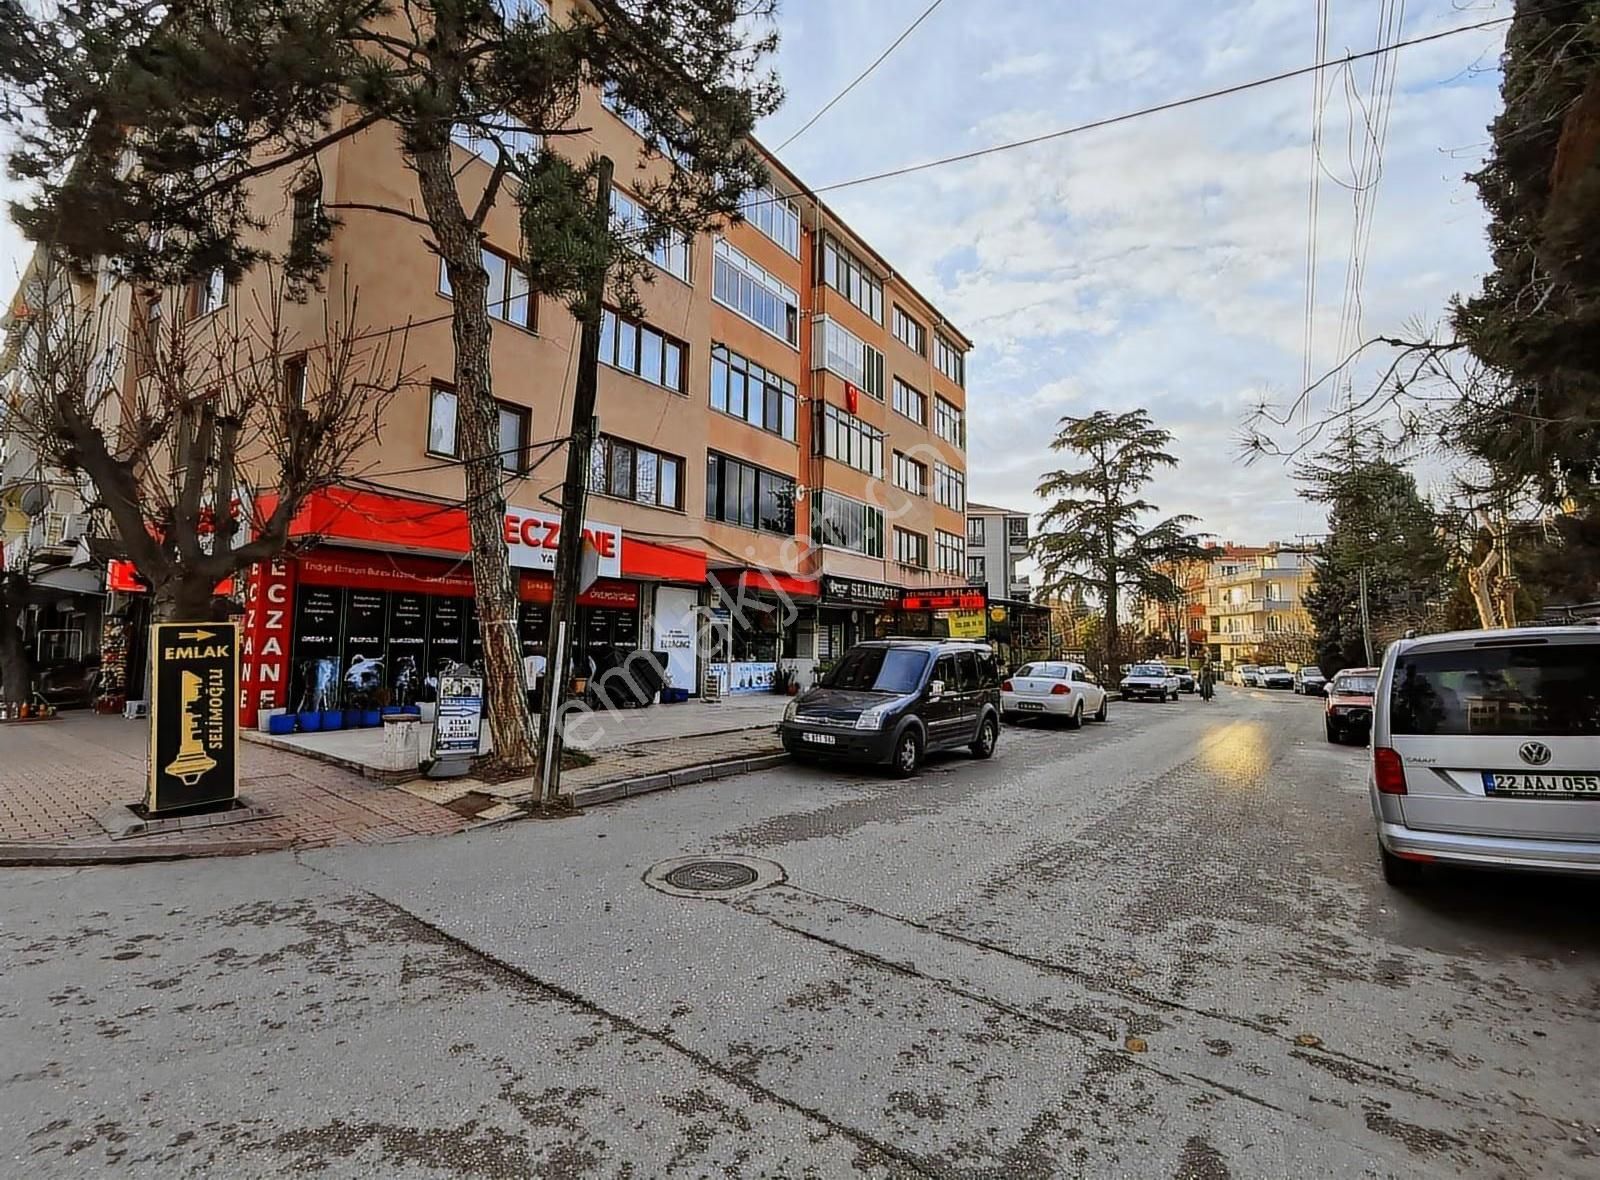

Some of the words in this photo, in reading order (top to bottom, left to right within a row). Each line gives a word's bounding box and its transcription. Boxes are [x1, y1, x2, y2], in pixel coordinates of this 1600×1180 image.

[503, 514, 616, 558] ECZNE
[259, 556, 287, 708] ECZANE
[164, 645, 230, 660] EMLAK
[1495, 775, 1518, 790] 22
[1523, 776, 1557, 790] AAJ
[1562, 776, 1598, 791] 055
